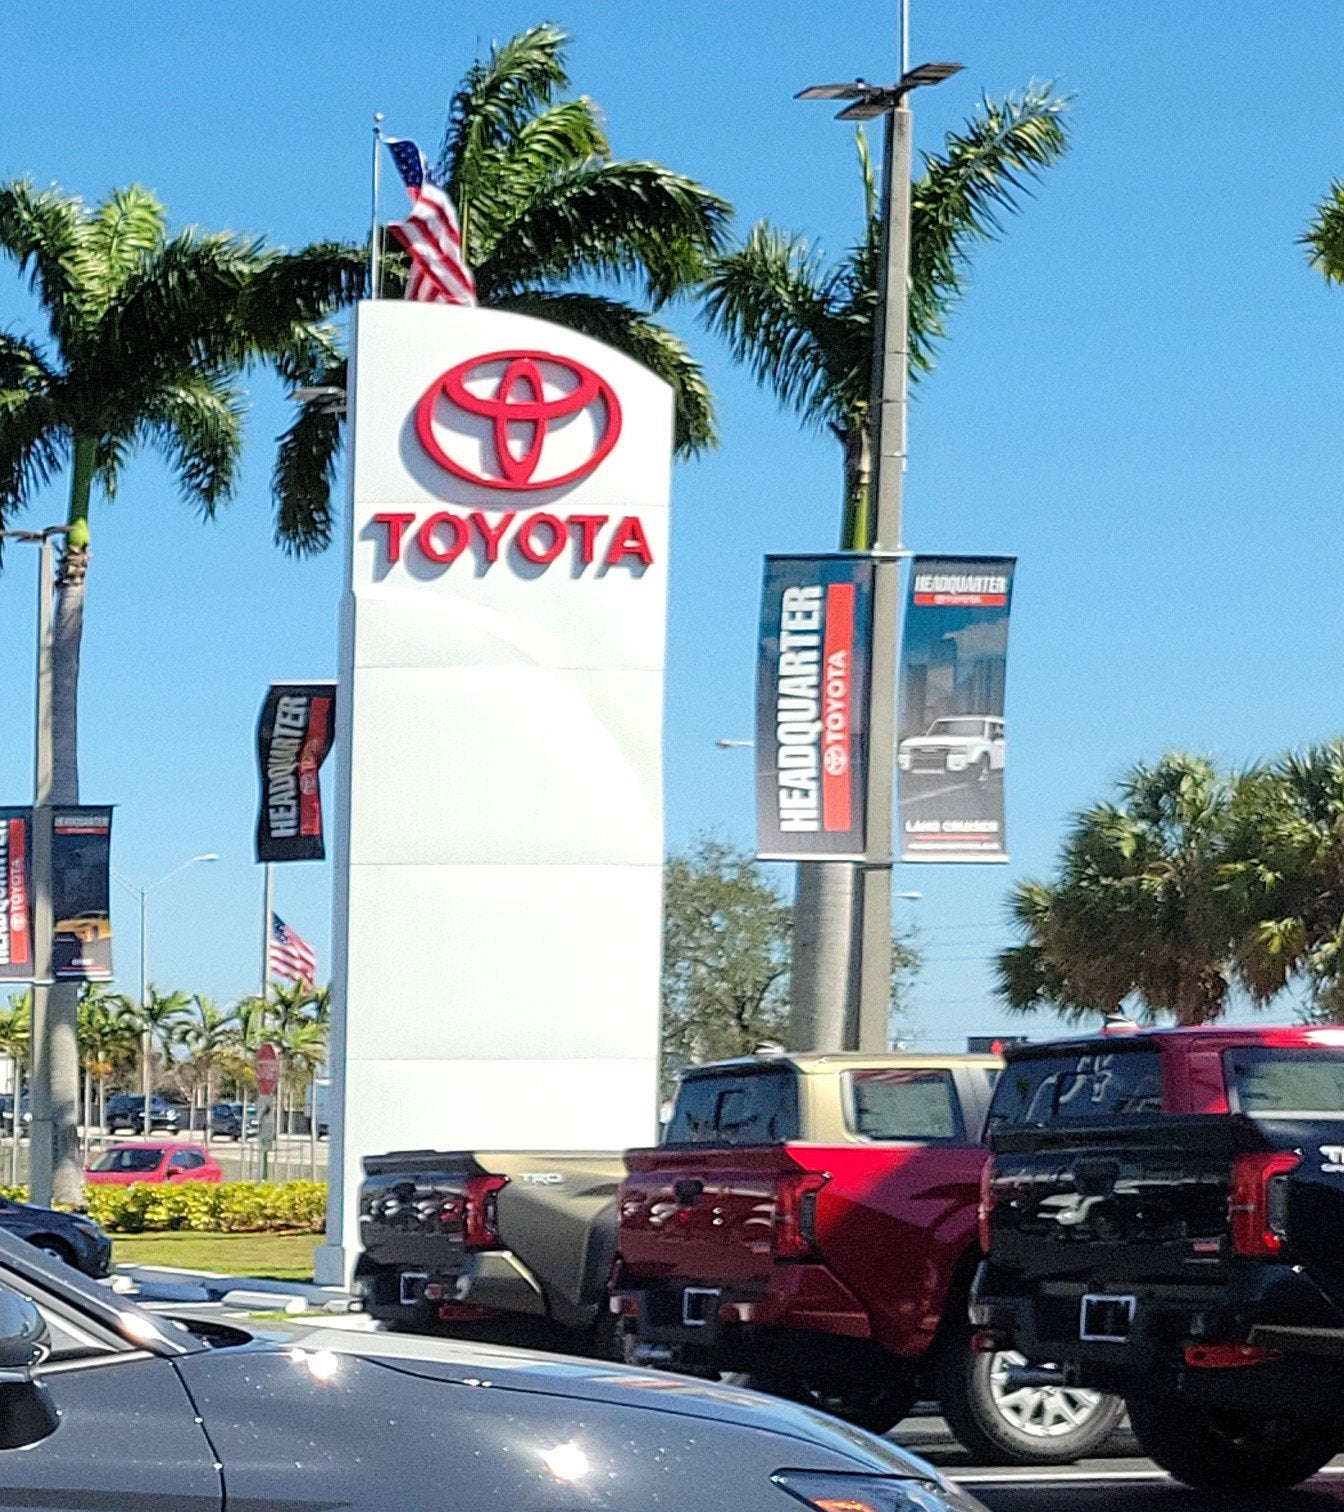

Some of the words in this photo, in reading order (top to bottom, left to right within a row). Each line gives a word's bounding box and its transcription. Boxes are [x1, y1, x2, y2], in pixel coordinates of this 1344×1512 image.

[373, 509, 653, 564] TOYOTA
[914, 575, 1005, 594] HEADQUARTER
[776, 584, 824, 833] HEADQUARTER
[825, 650, 847, 745] TOYOTA
[518, 1173, 562, 1185] TRD
